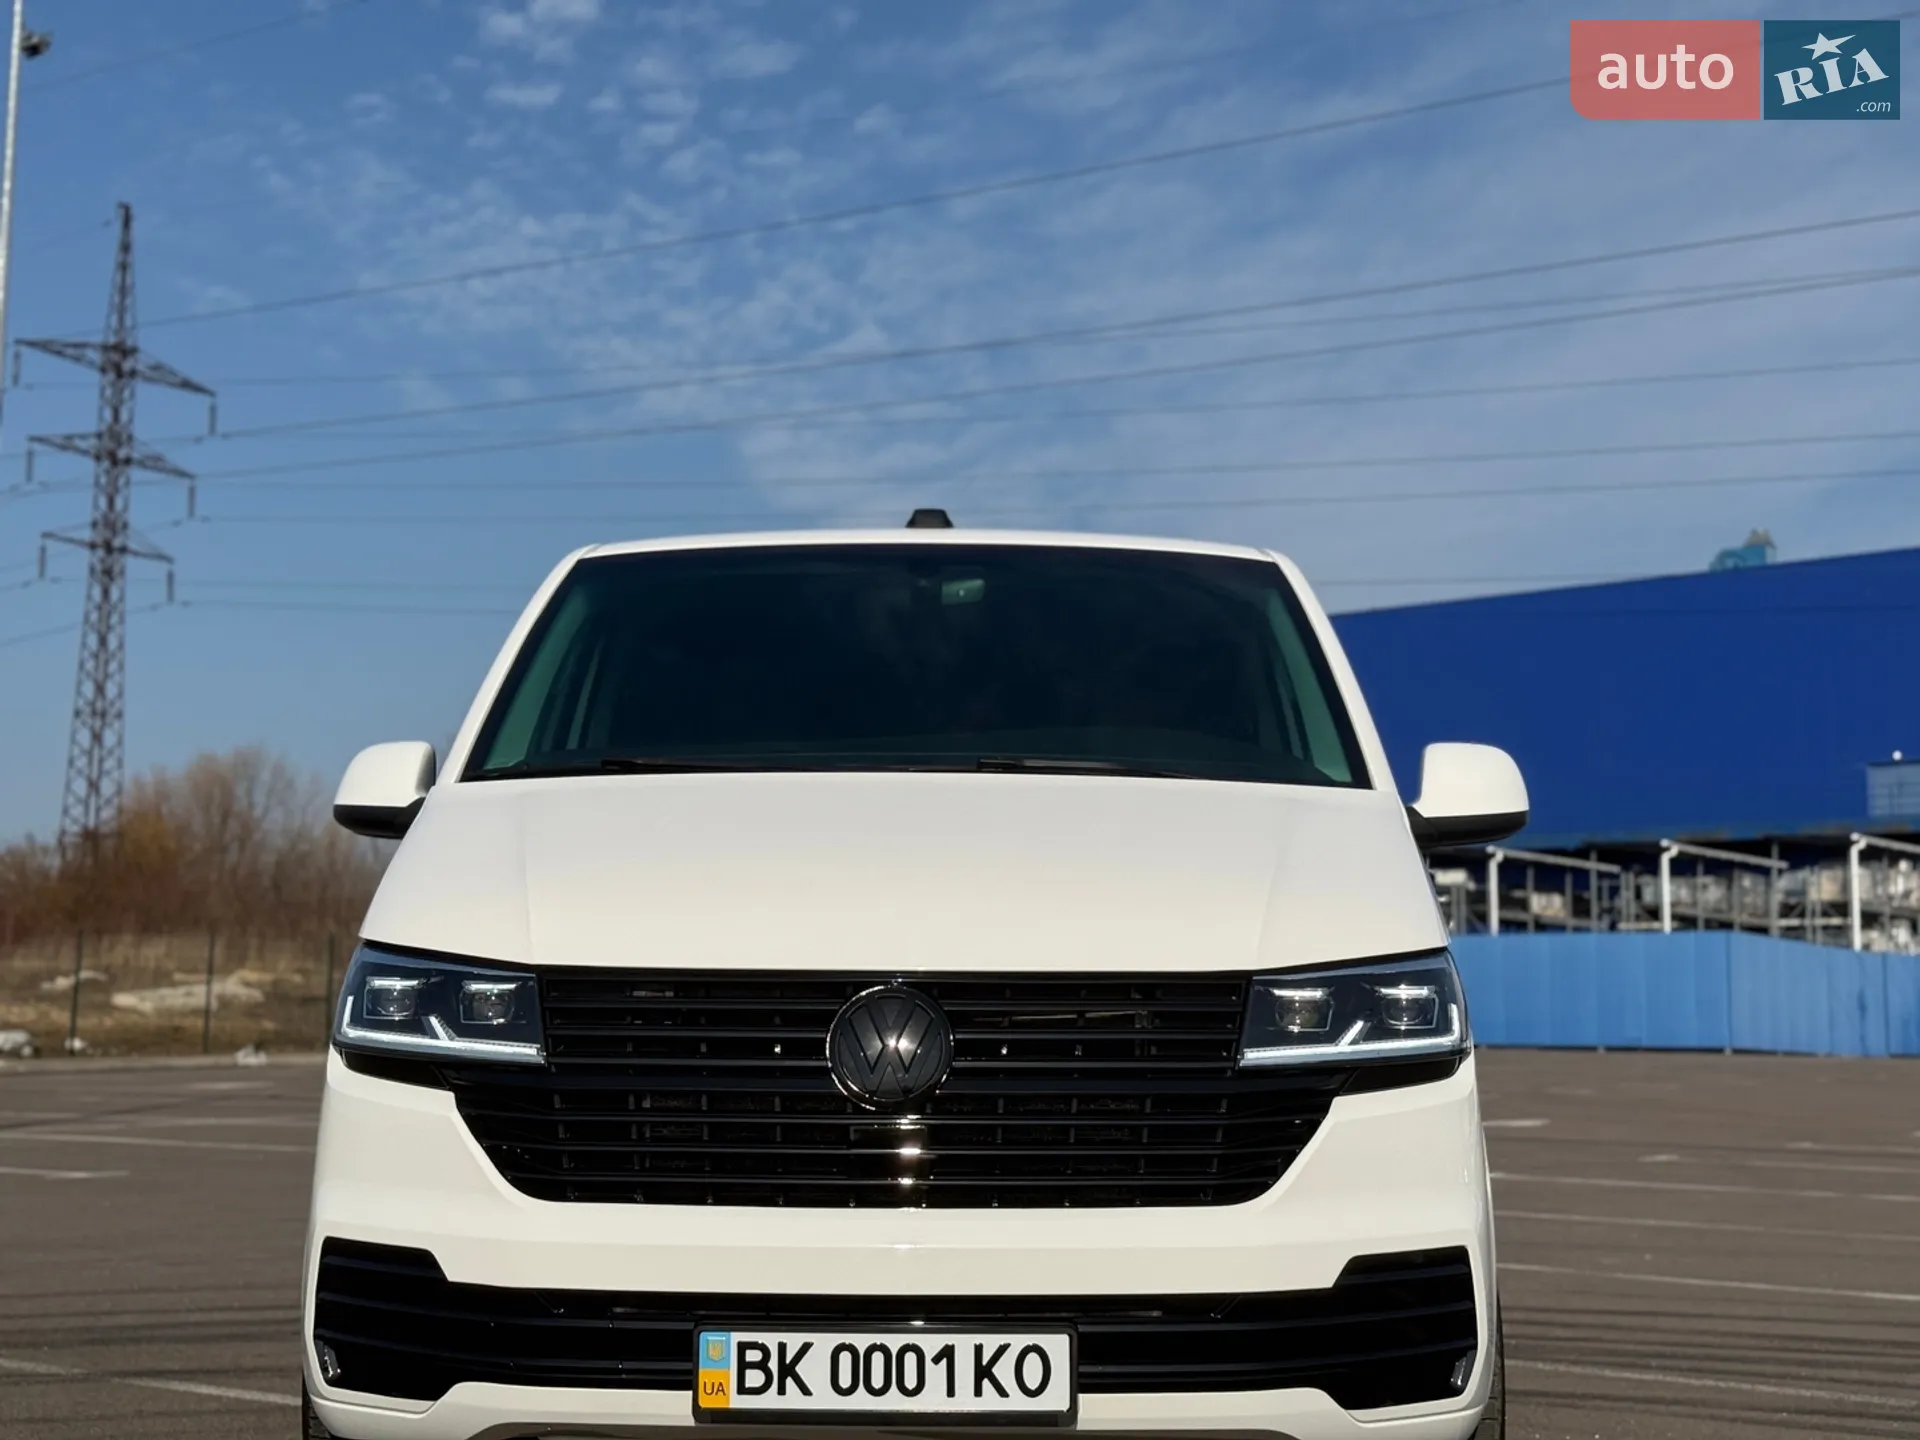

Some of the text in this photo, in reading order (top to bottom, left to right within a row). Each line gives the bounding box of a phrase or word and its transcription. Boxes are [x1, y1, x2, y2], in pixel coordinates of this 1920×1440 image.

[736, 1340, 1052, 1398] BK 0001 KO
[703, 1380, 727, 1397] UA
